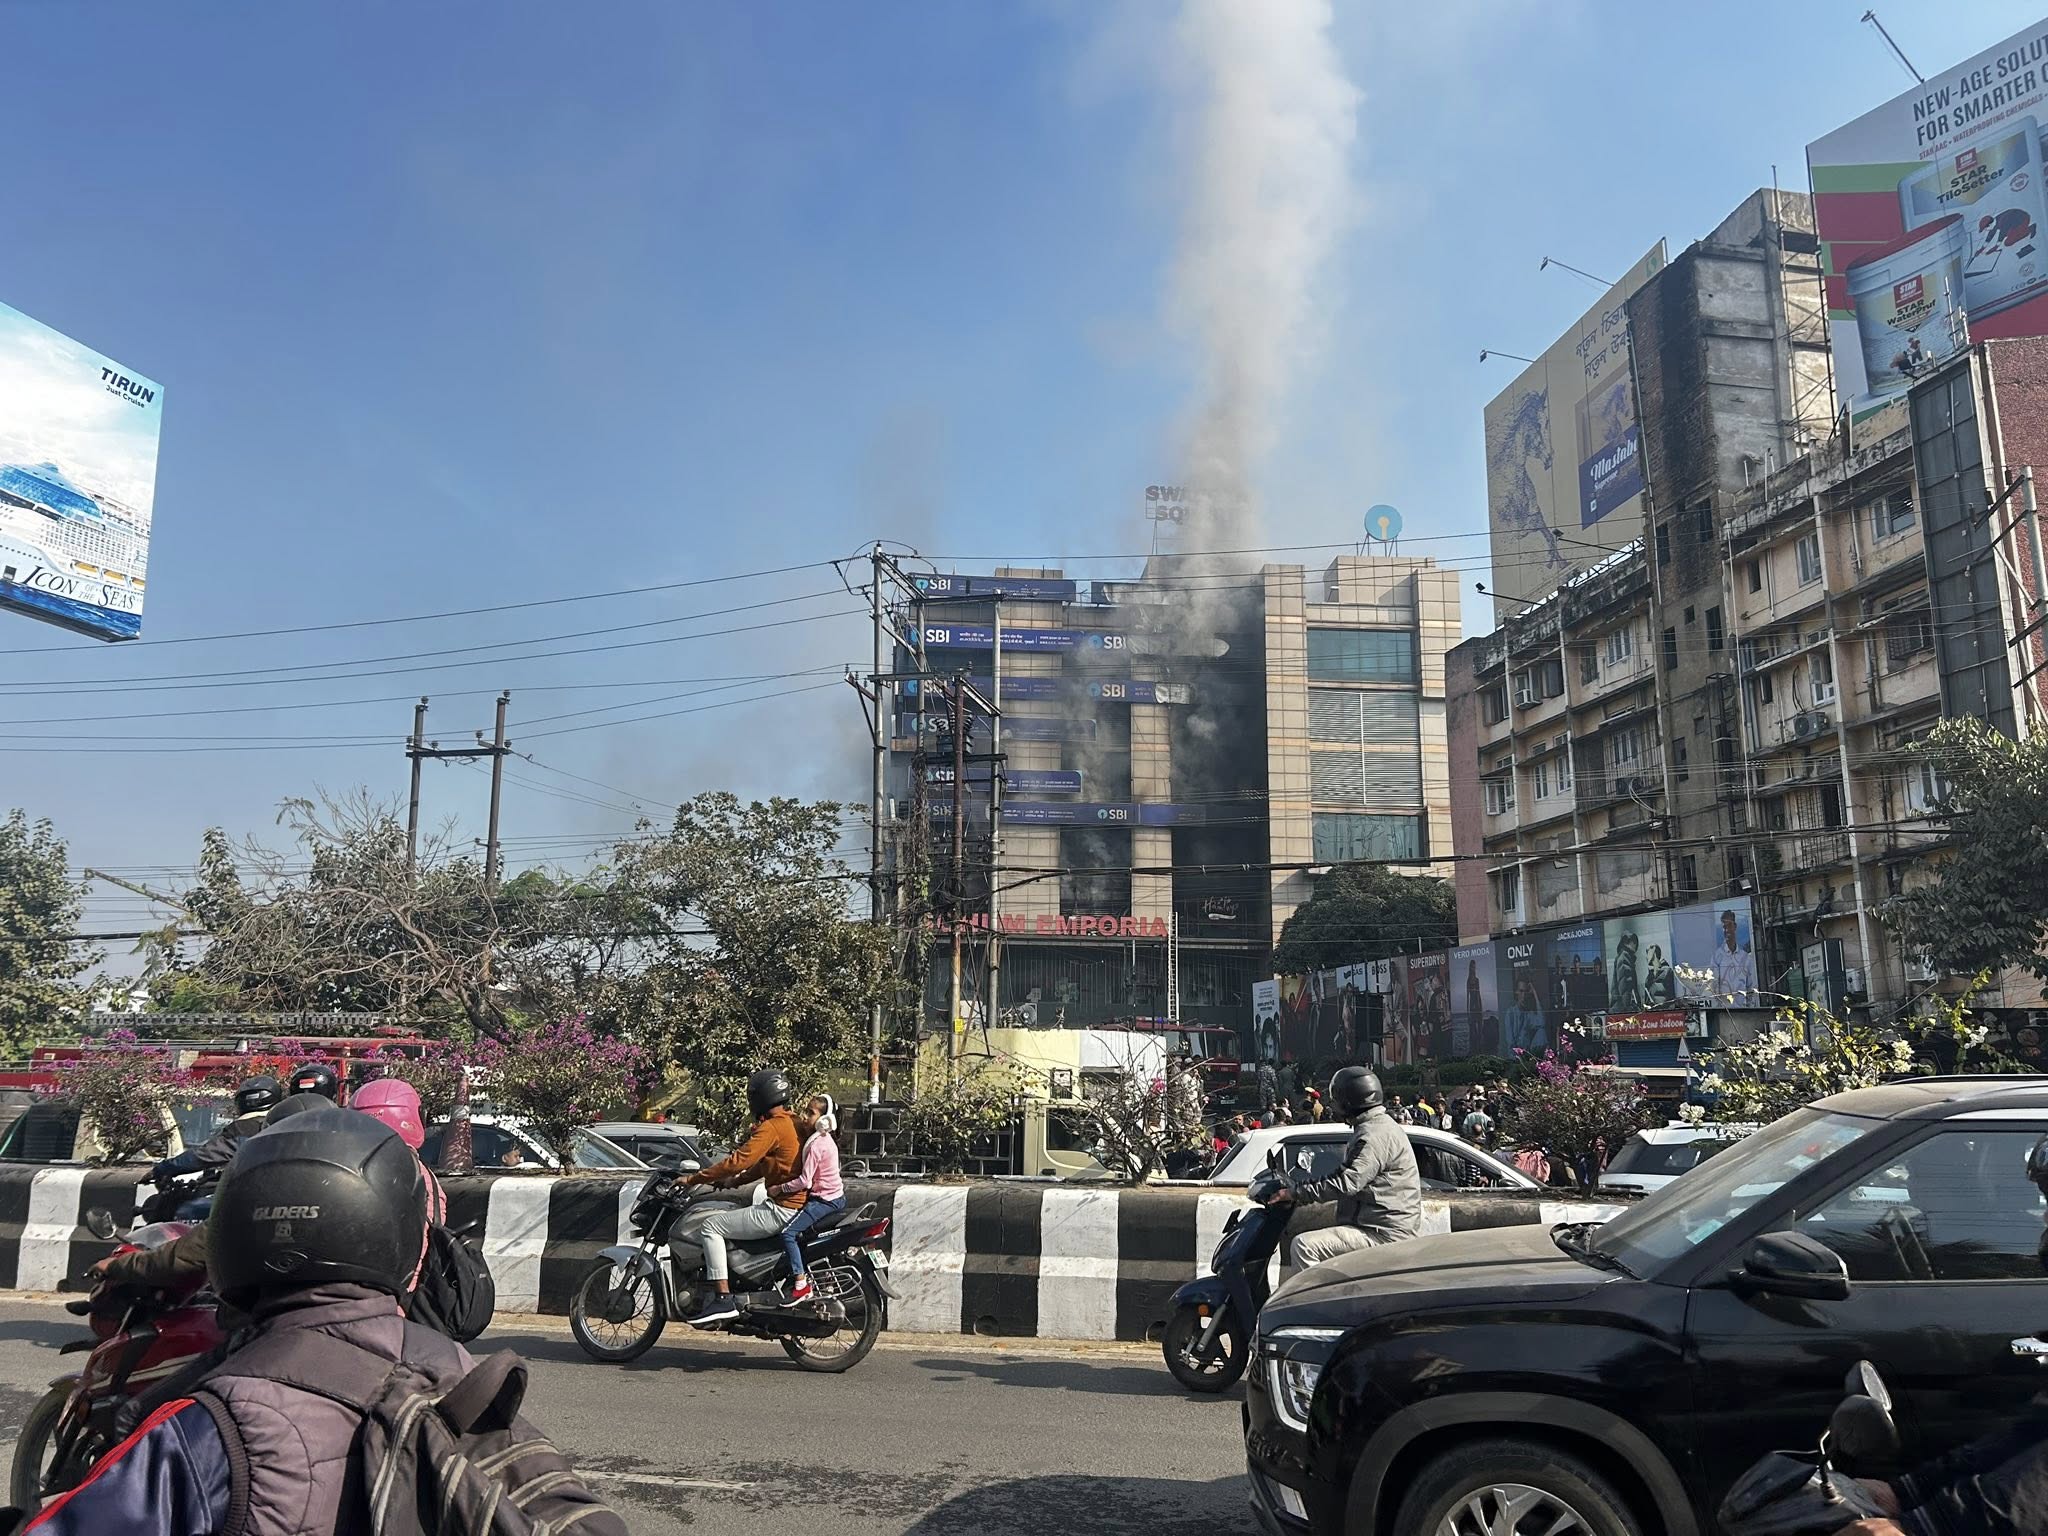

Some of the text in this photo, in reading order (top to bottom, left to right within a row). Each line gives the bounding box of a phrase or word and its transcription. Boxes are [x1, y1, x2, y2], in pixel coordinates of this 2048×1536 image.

[1913, 65, 1993, 121] NEW-AGE
[1917, 114, 1949, 146] FOR
[1953, 70, 2036, 127] SMARTER
[1952, 113, 2006, 144] WATERPROOFING
[2006, 93, 2043, 117] CHEMICALS
[1951, 164, 1987, 188] STAR
[1887, 299, 1936, 326] WaterPruf
[1897, 299, 1924, 316] STAR
[102, 366, 154, 403] TIRUN
[106, 385, 145, 408] Just Cruise
[21, 565, 79, 595] ICON
[929, 579, 951, 591] SBI
[98, 584, 136, 610] SEAS
[926, 629, 950, 643] SBI
[1103, 635, 1127, 649] SBI
[1102, 684, 1126, 697] SBI
[1109, 809, 1127, 819] SBI
[1036, 914, 1171, 937] EMPORIA
[1557, 928, 1594, 940] JACK&JONES
[1453, 947, 1490, 959] VERO MODA
[1507, 944, 1534, 959] ONLY
[1659, 1018, 1684, 1028] Saloon
[253, 1205, 320, 1220] GLIDERS
